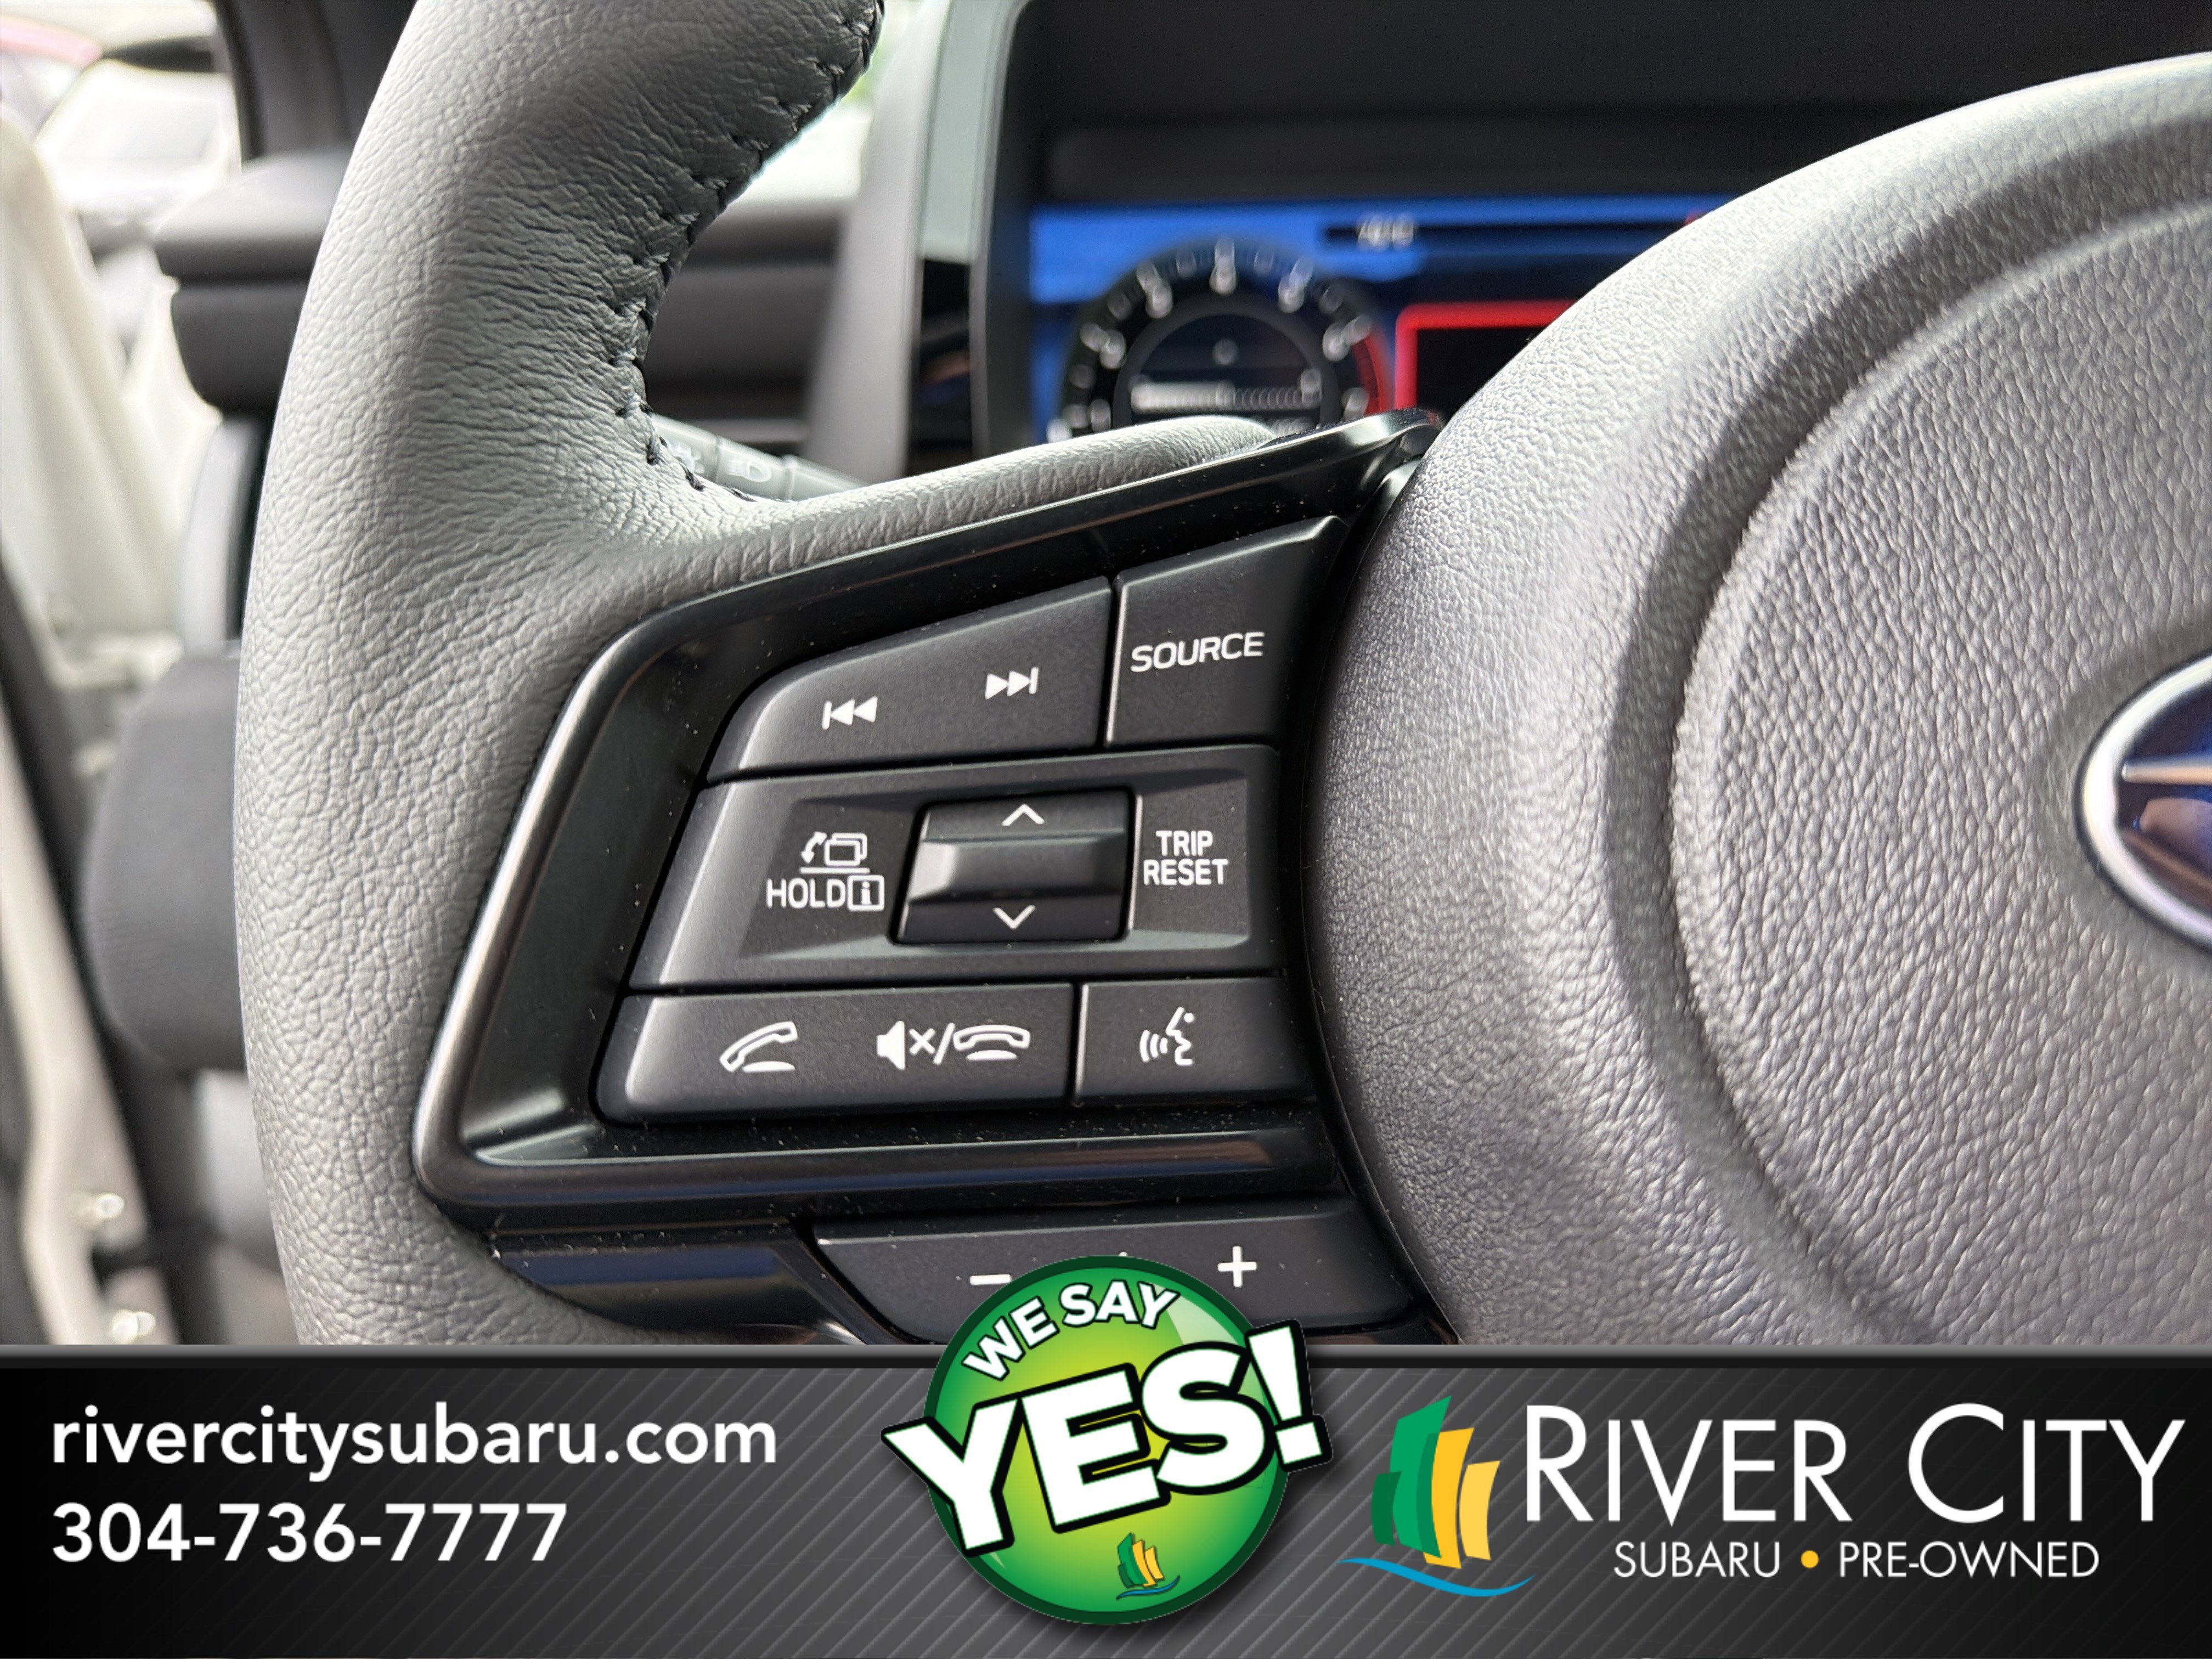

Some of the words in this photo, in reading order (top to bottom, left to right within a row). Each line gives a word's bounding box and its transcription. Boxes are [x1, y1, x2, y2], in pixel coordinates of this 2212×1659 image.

[1130, 631, 1265, 673] SOURCE
[1155, 830, 1214, 857] TRIP
[1143, 857, 1230, 887] RESET
[765, 877, 847, 910] HOLD
